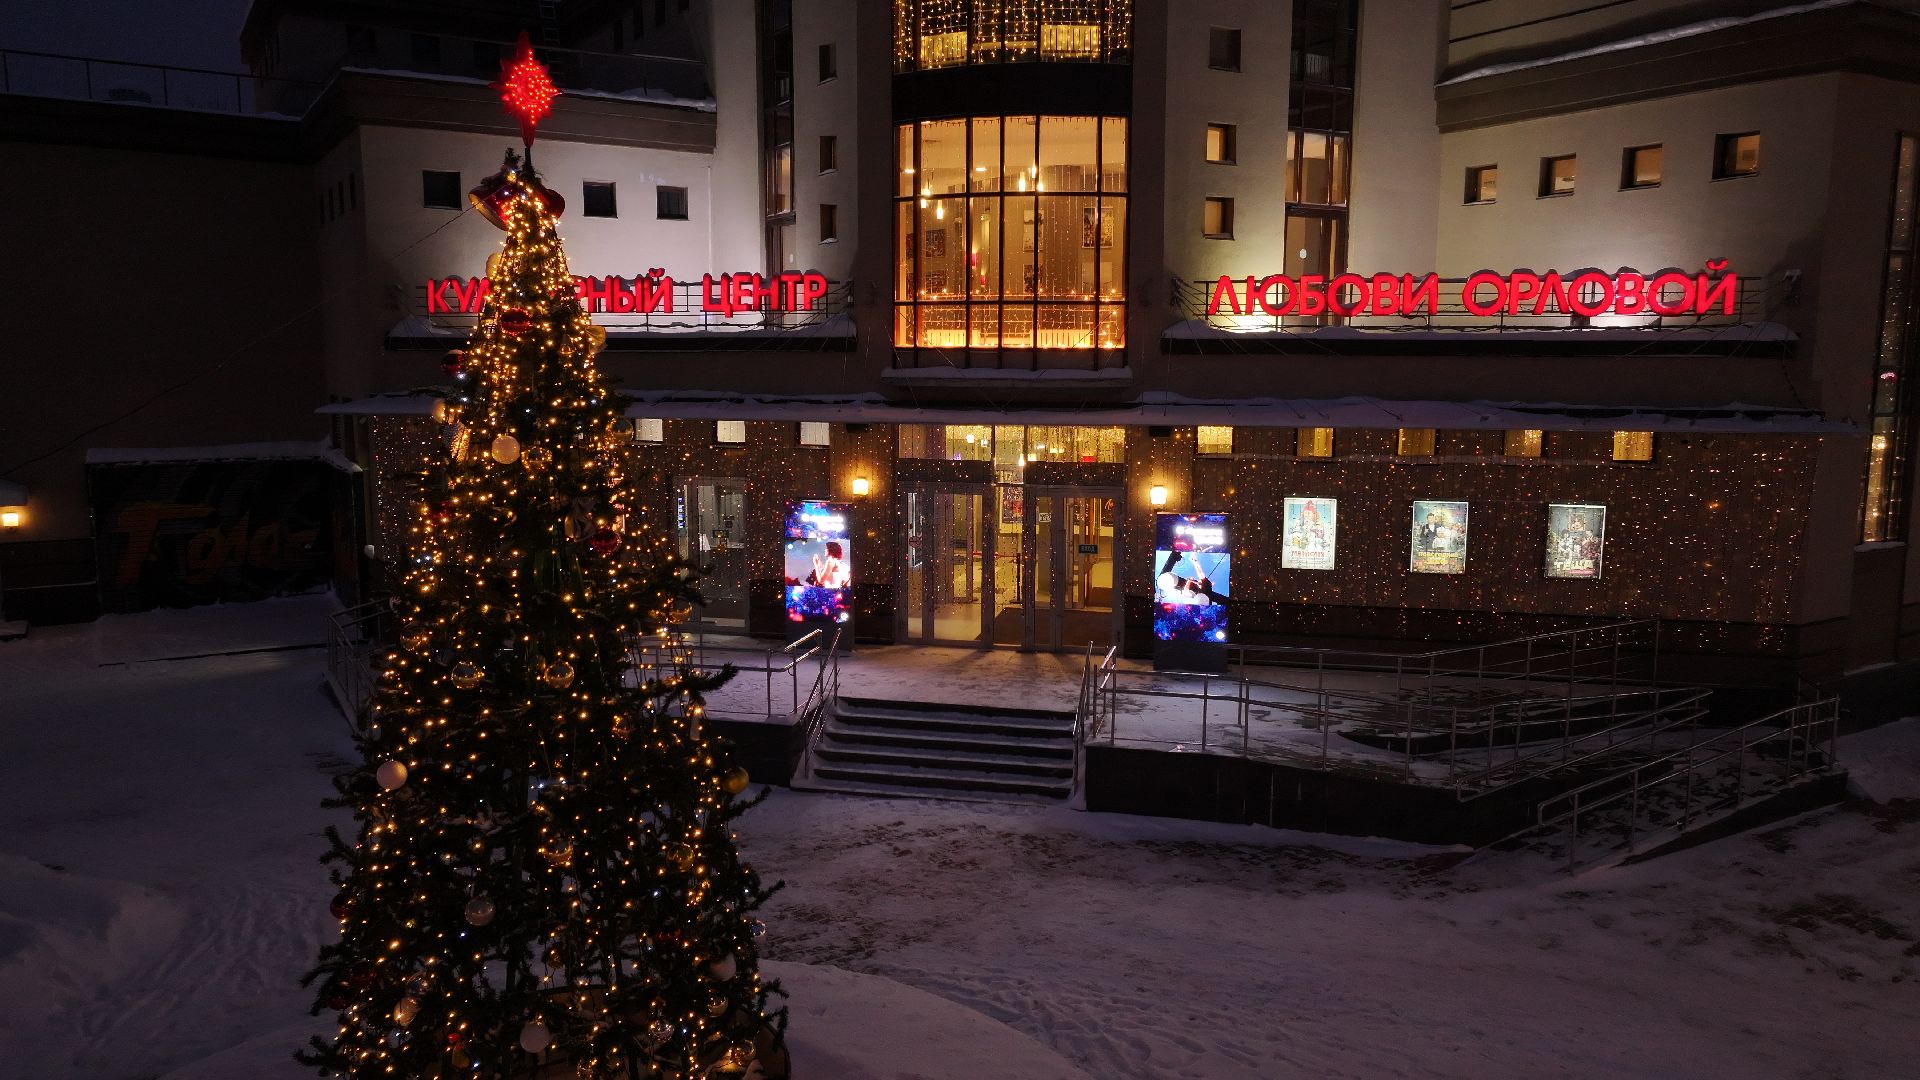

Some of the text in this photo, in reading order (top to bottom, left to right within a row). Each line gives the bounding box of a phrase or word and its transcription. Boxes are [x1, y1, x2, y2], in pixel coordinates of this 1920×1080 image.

[701, 273, 827, 319] ЦЕНТР
[1207, 258, 1738, 317] ЛЮБОВИ ОРЛОВОЙ
